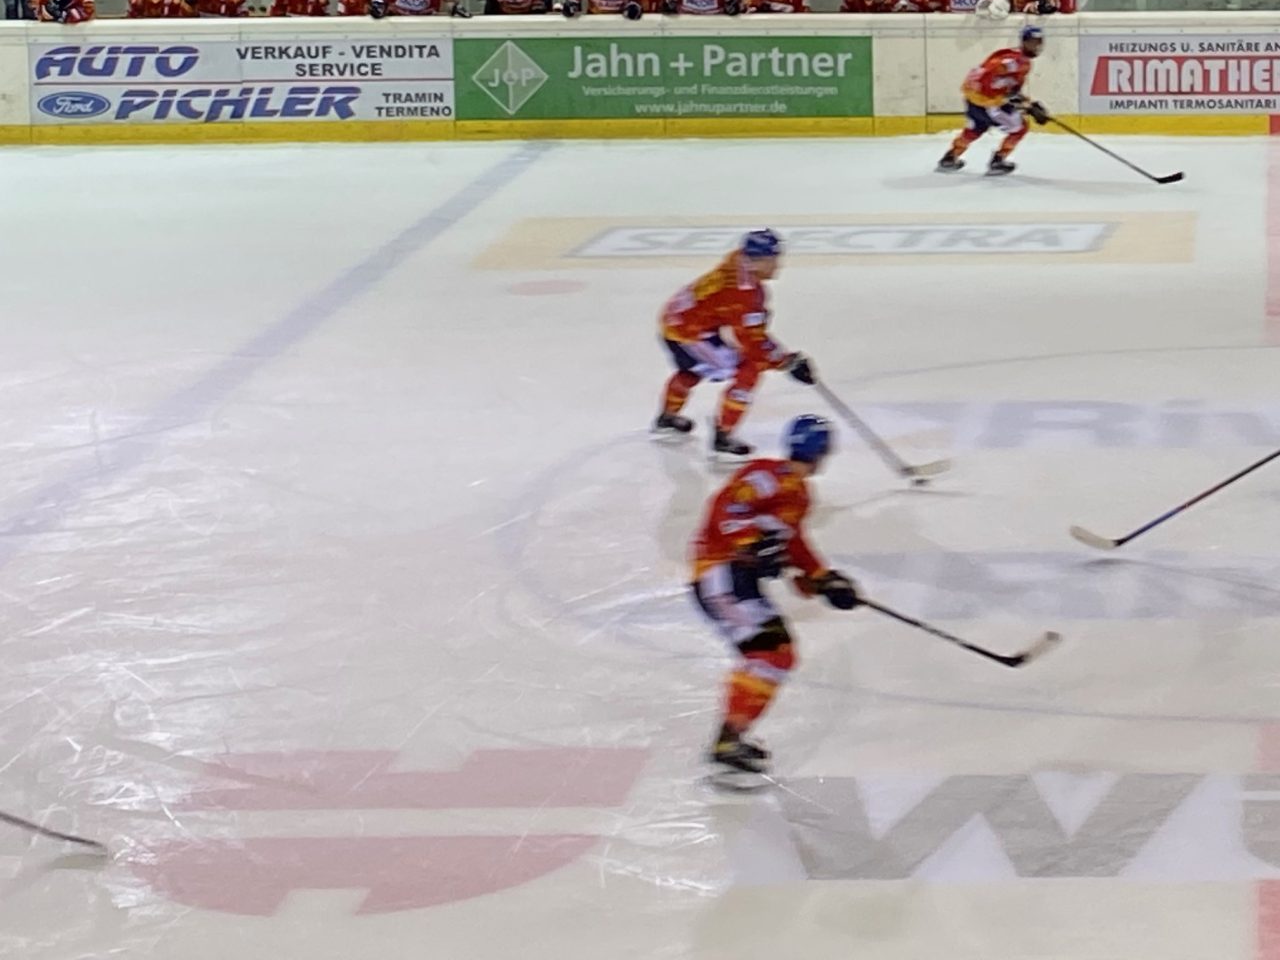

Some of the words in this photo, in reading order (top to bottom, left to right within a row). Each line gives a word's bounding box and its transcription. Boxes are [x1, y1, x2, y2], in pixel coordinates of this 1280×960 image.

[236, 46, 333, 61] VERKAUF
[351, 44, 440, 60] VENDITA
[1109, 42, 1177, 53] HEIZUNGS
[1181, 43, 1195, 53] U.
[1199, 39, 1260, 53] SANITÄRE
[35, 45, 200, 81] AUTO
[567, 43, 661, 79] Jahn
[703, 44, 853, 79] Partner
[295, 62, 383, 77] SERVICE
[674, 84, 697, 96] und
[52, 96, 92, 115] Ford
[115, 86, 362, 122] PICHLER
[381, 92, 445, 105] TRAMIN
[1109, 99, 1169, 110] IMPIANTI
[1173, 98, 1277, 110] TERMOSANITARI
[375, 105, 452, 118] TERMENO
[617, 228, 1064, 251] SEECTRA
